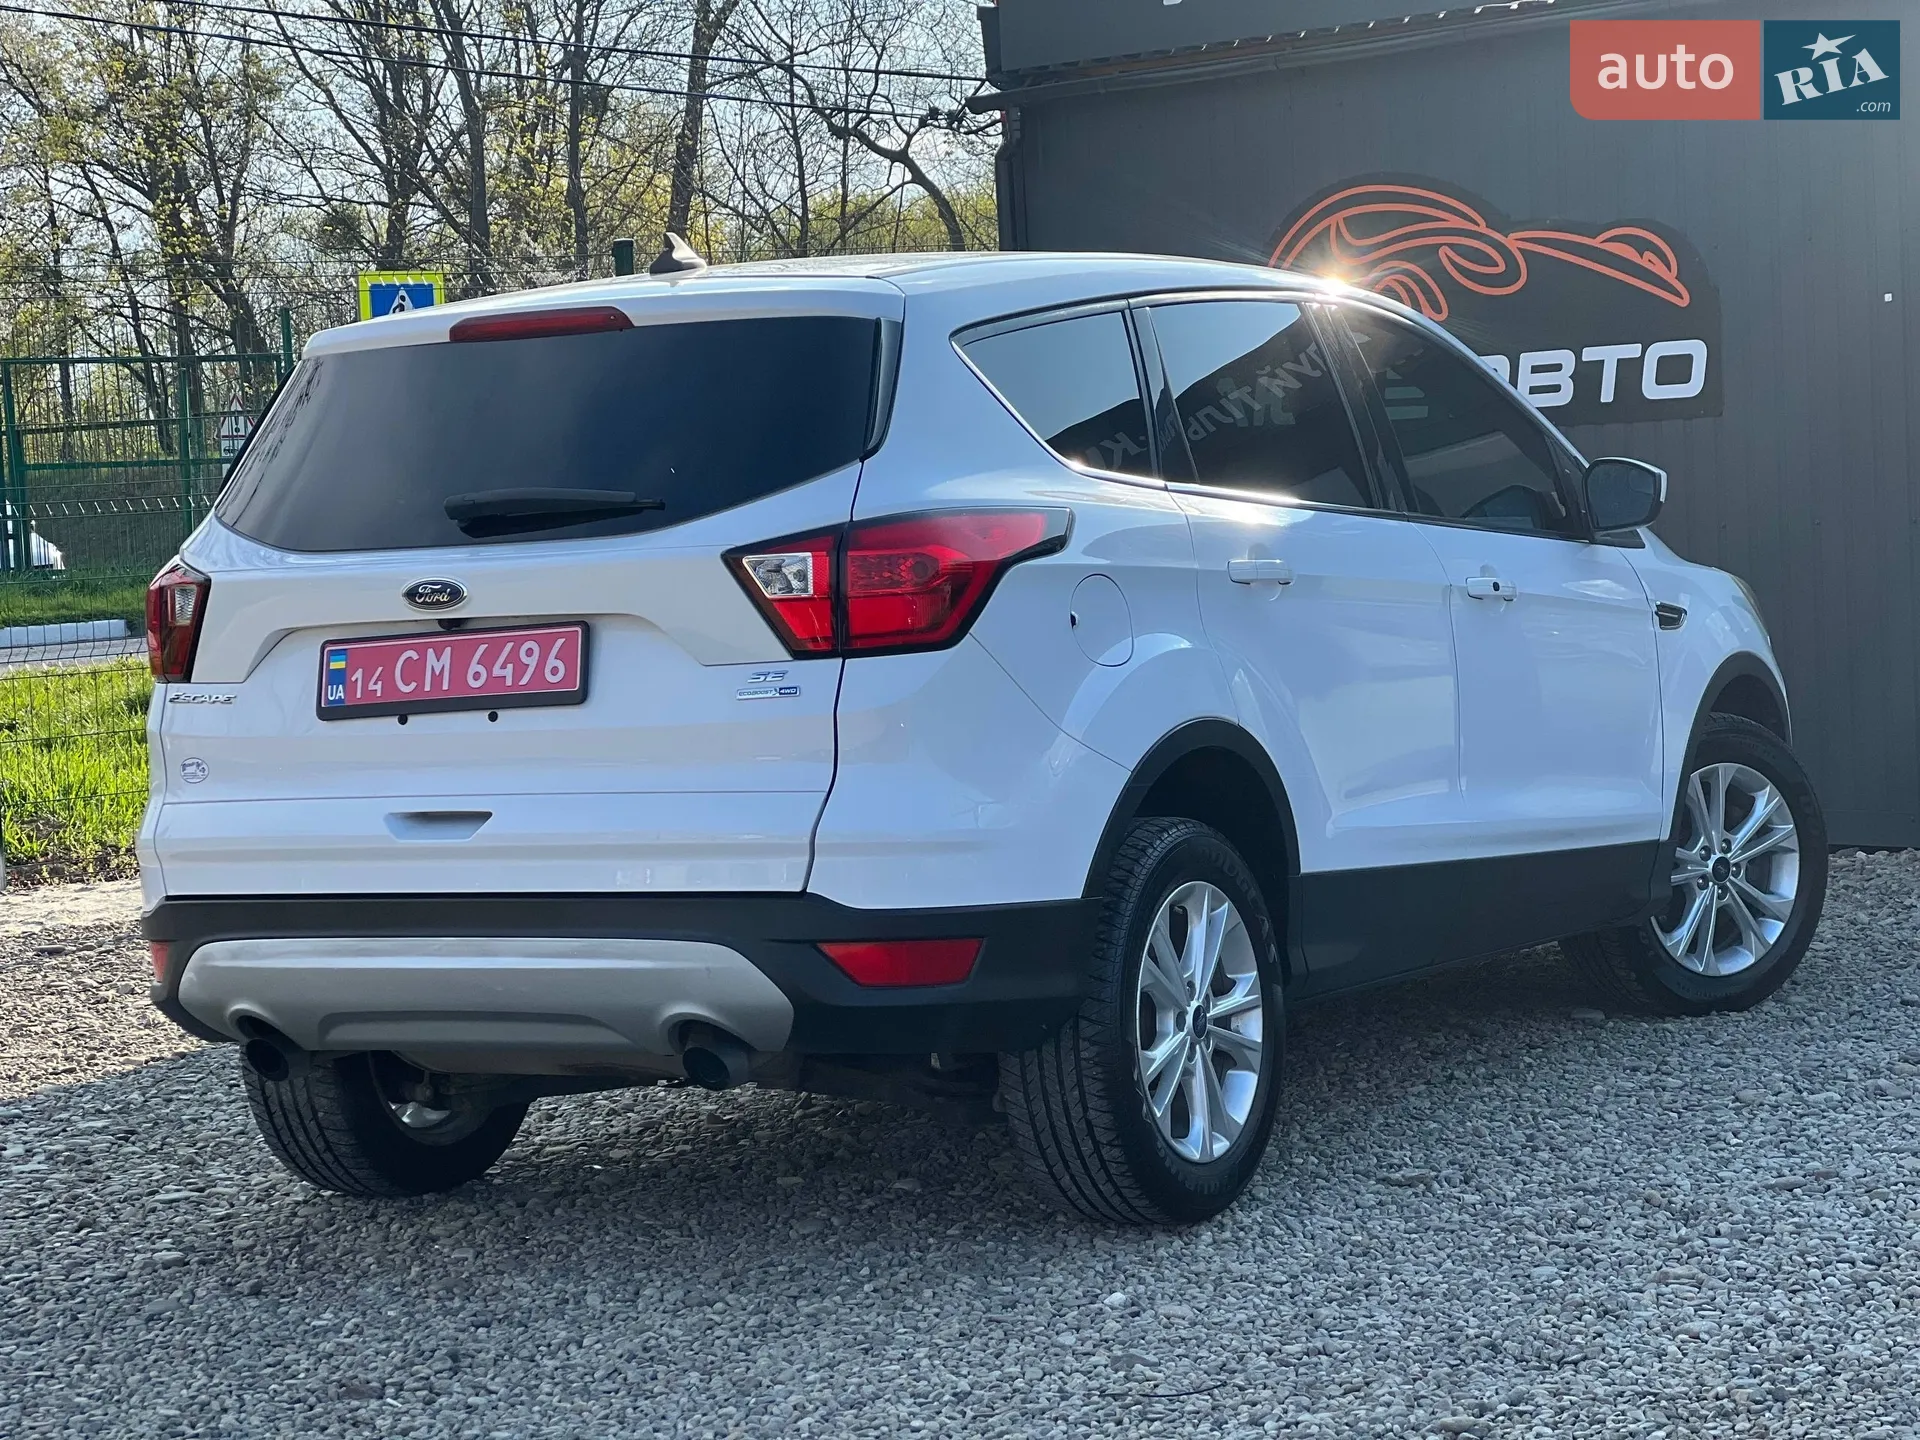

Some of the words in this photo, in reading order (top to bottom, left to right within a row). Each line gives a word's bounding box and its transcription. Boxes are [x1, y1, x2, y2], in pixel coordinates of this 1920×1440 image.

[416, 585, 450, 603] Ford
[351, 667, 383, 698] 14
[394, 647, 452, 693] CM
[466, 638, 566, 688] 6496
[747, 670, 789, 684] SE
[168, 692, 237, 705] ESCAPE
[327, 684, 345, 700] UA
